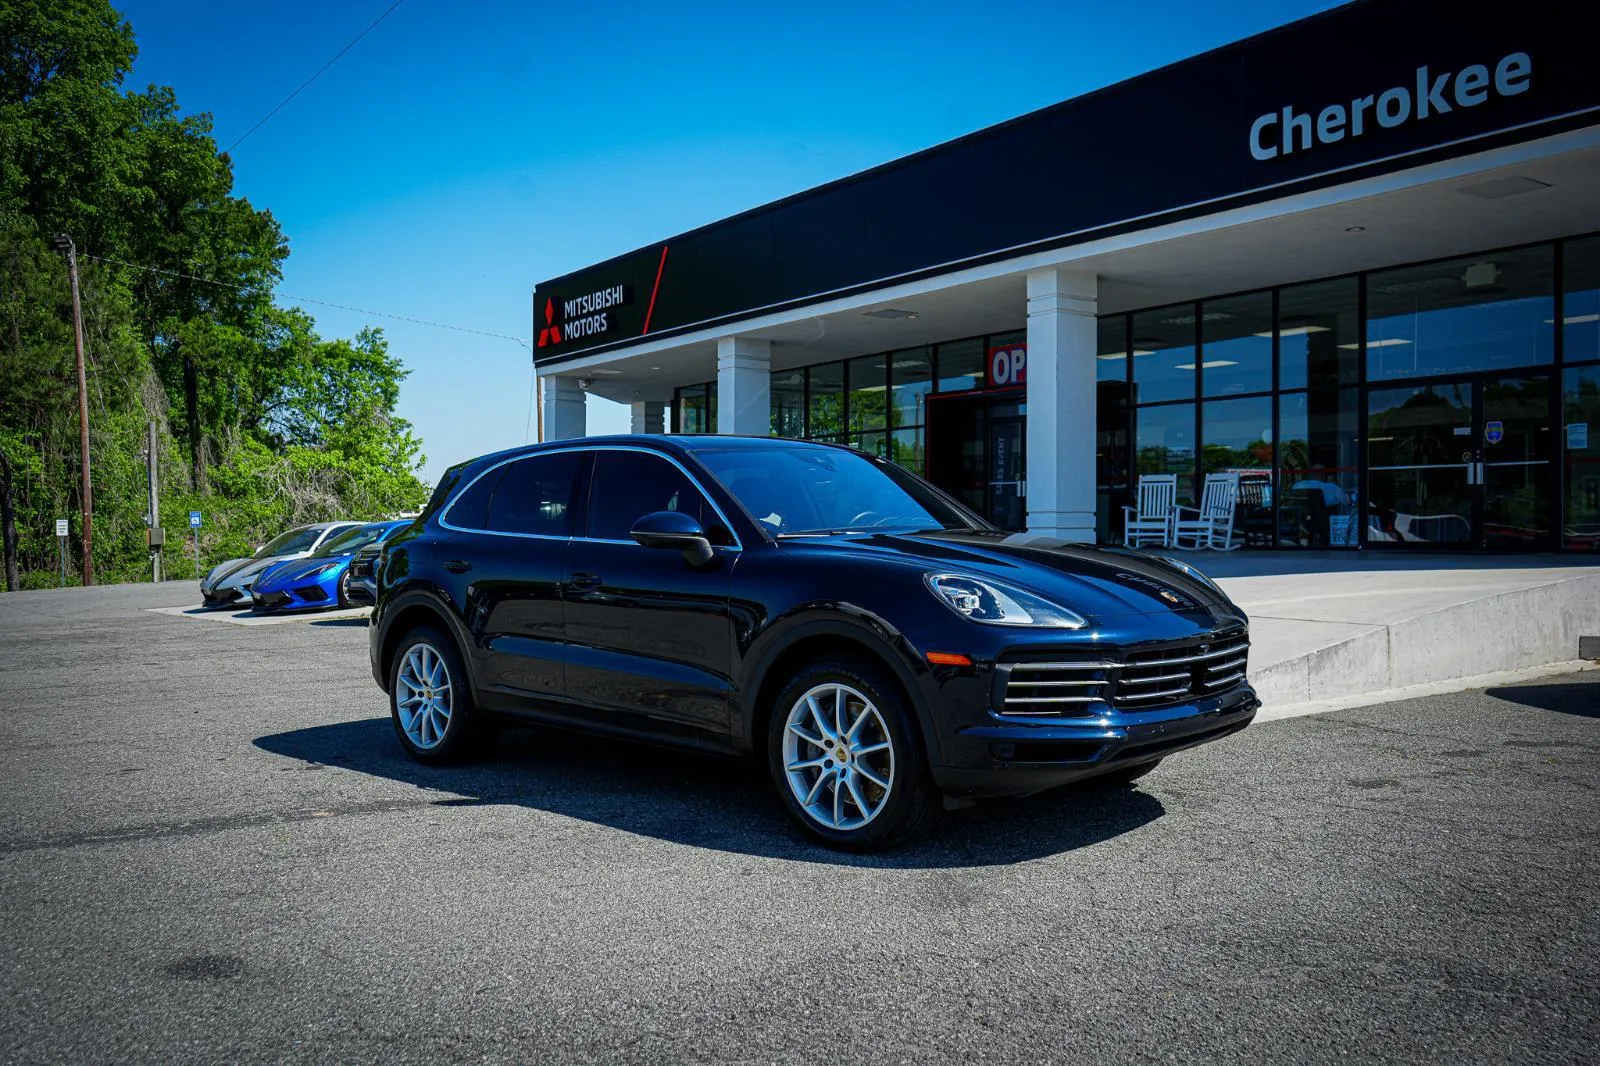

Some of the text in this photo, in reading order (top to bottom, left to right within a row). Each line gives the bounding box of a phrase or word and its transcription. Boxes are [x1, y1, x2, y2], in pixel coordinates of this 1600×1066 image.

[1249, 51, 1532, 161] Cherokee
[564, 284, 624, 319] MITSUBISHI
[564, 312, 607, 341] MOTORS
